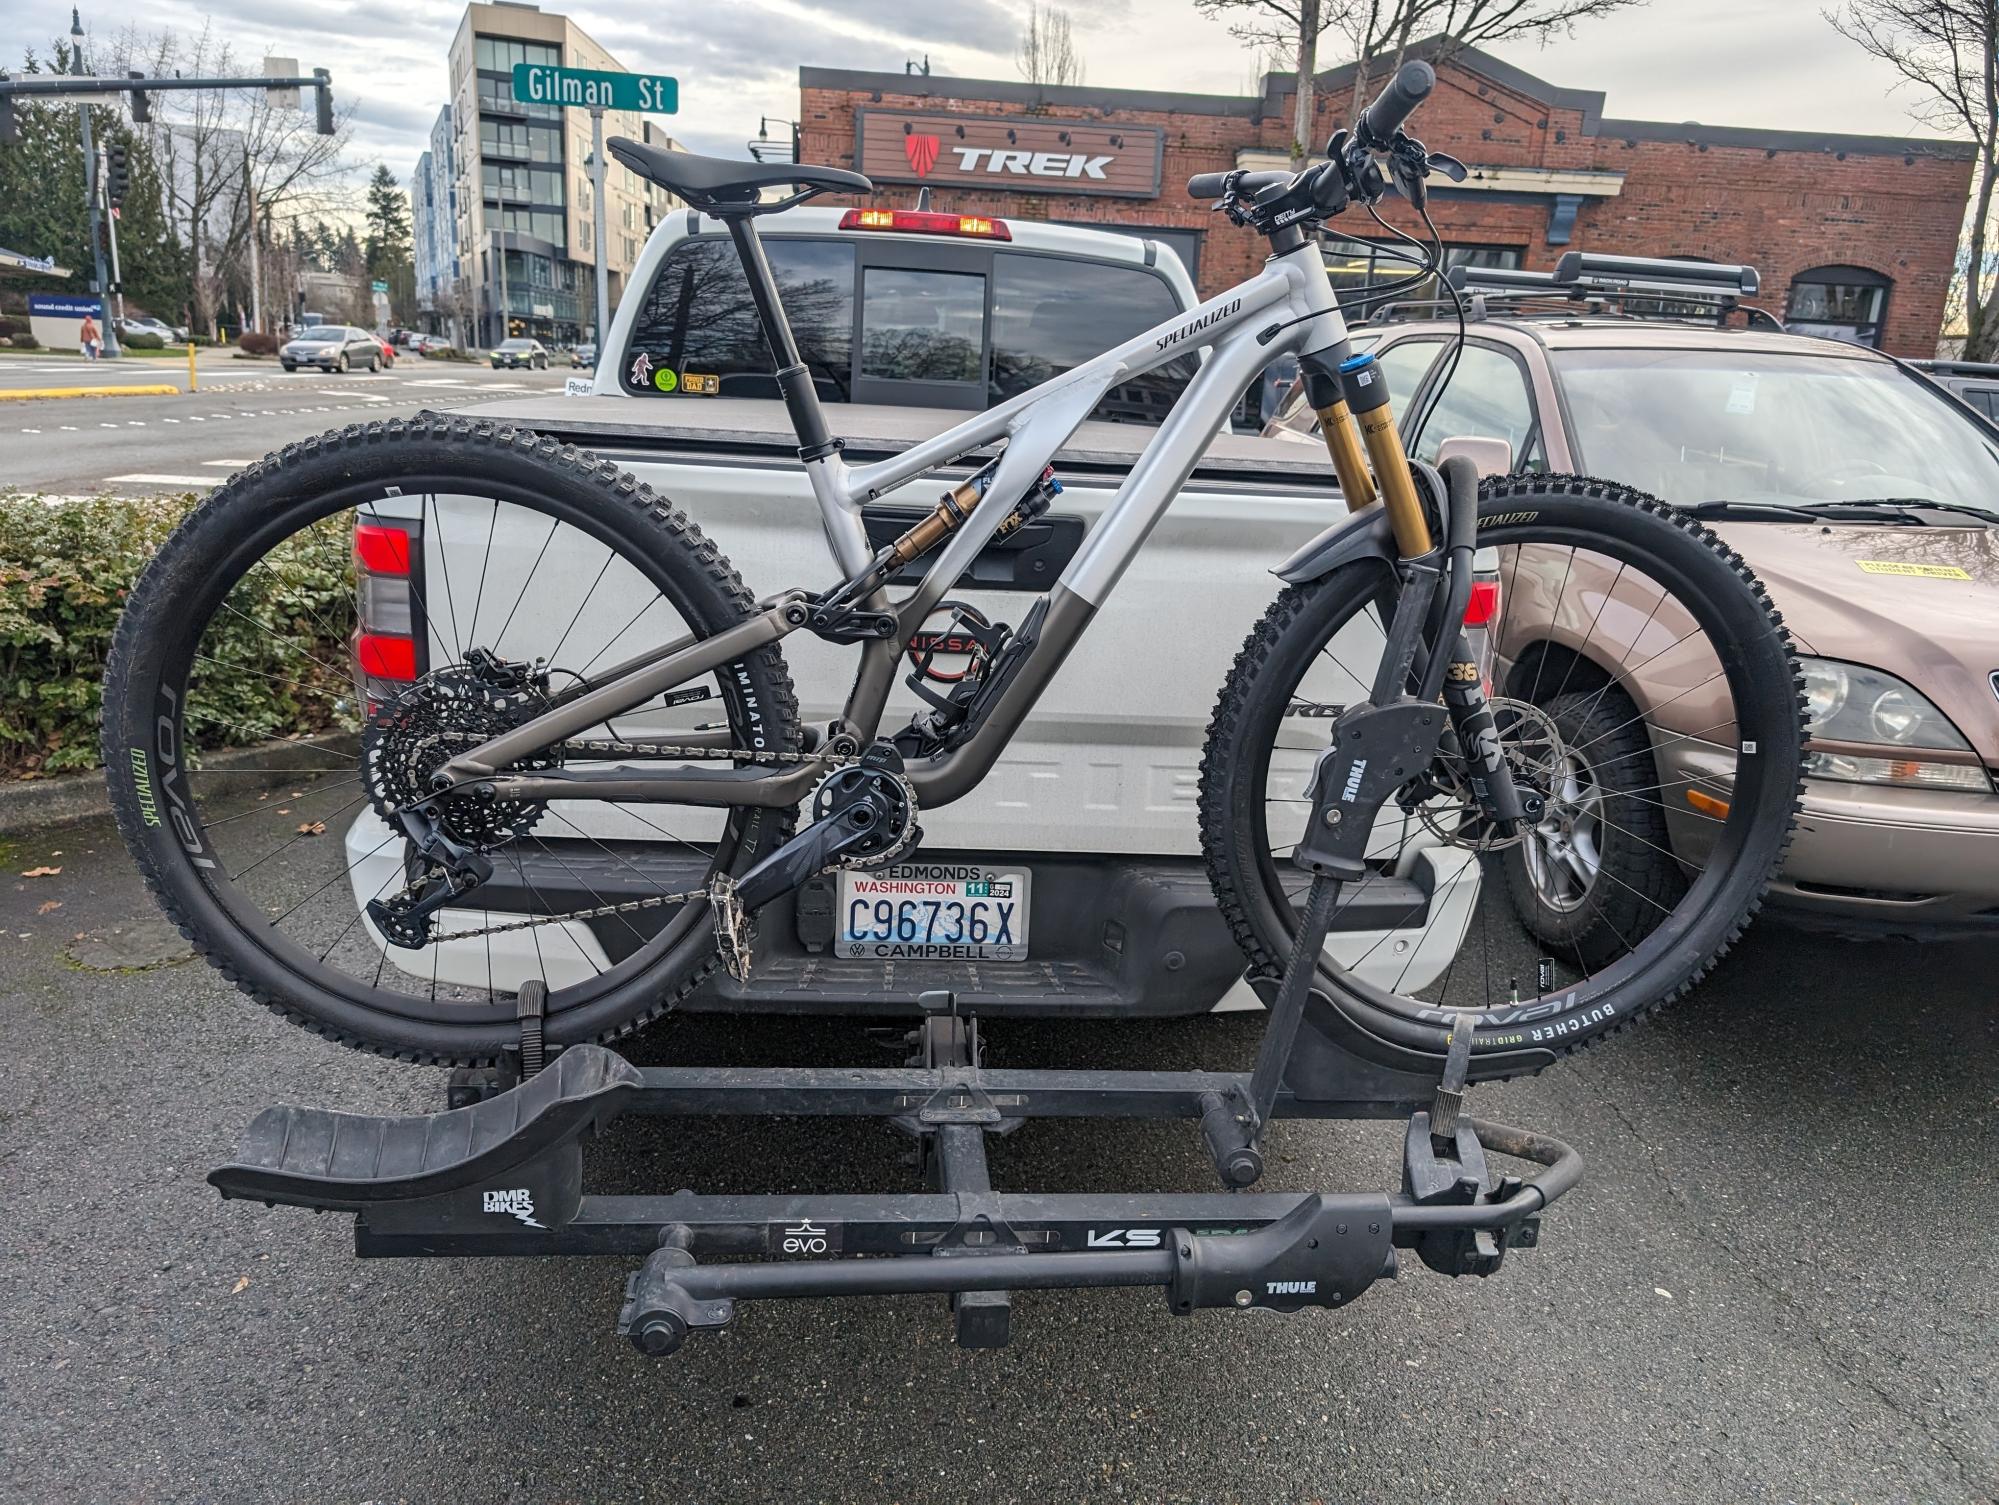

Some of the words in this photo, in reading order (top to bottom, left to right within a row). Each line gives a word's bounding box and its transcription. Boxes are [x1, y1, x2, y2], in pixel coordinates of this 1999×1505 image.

[529, 68, 613, 106] Gilman
[638, 78, 664, 110] St
[952, 147, 1115, 179] TREK
[1156, 297, 1242, 353] SPECIALIZED
[686, 382, 702, 391] DAD
[1000, 511, 1023, 534] FOX
[1477, 511, 1539, 528] ECIALIZED
[734, 663, 766, 762] IMINATO
[158, 682, 216, 869] roval
[1341, 759, 1367, 803] THULE
[130, 747, 162, 828] SPECIALIZED
[751, 807, 762, 832] RAIL
[889, 866, 980, 881] EDMONDS
[854, 881, 956, 895] WASHINGTON
[967, 884, 983, 894] 11
[989, 889, 1010, 897] 2024
[850, 898, 1015, 945] C96736X
[874, 944, 990, 959] CAMPBELL
[1531, 1003, 1615, 1042] BUTCHER
[483, 1189, 530, 1202] DMR
[483, 1200, 534, 1214] BIKES
[783, 1238, 826, 1253] evo
[1266, 1281, 1317, 1294] THULE
